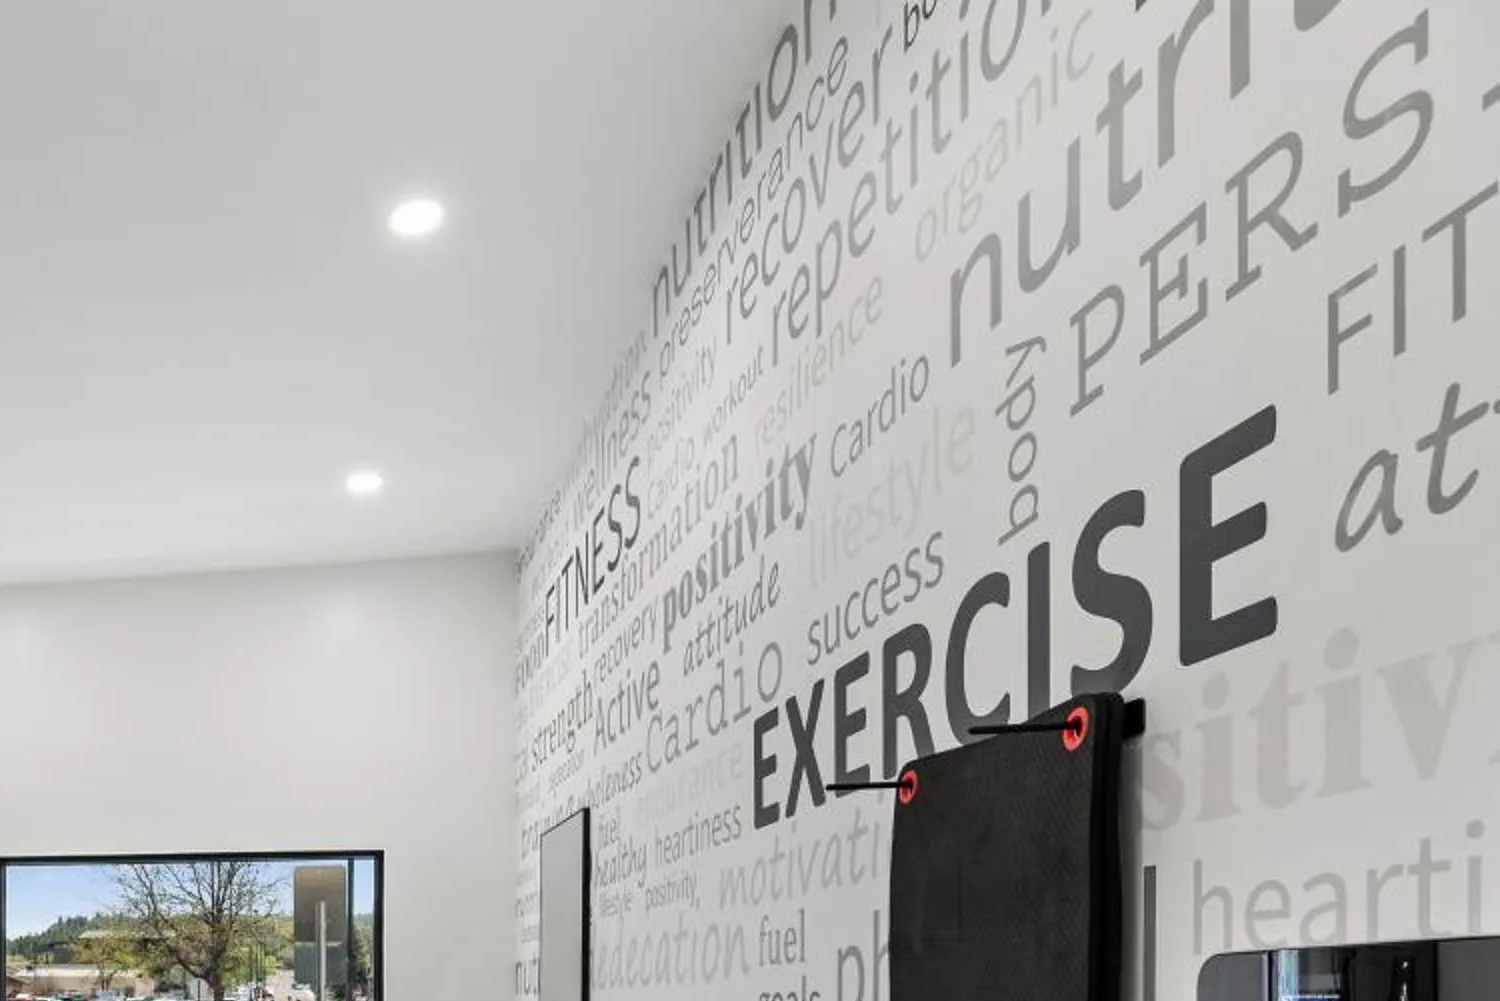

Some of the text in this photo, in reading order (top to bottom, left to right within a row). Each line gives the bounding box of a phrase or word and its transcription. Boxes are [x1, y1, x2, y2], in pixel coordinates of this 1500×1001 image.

[727, 24, 892, 345] recover
[770, 0, 1057, 368] repetitio
[915, 8, 1094, 262] organic
[1070, 8, 1500, 416] PERS
[755, 275, 883, 454] resilience
[1328, 182, 1499, 395] FIT
[831, 355, 929, 478] Cardio
[996, 336, 1046, 545] body
[1335, 383, 1500, 553] at
[546, 456, 640, 657] FITNESS
[579, 434, 739, 657] transformation
[663, 433, 817, 655] positivity
[683, 553, 781, 678] attitude
[754, 404, 1278, 829] EXERCISE
[807, 531, 944, 666] success
[594, 660, 660, 755] Active
[646, 641, 782, 774] Cardio
[1138, 627, 1500, 831] sitiv
[654, 805, 742, 867] heartiness
[719, 788, 884, 911] motivati
[1194, 819, 1481, 956] hearti
[759, 908, 805, 967] fuel
